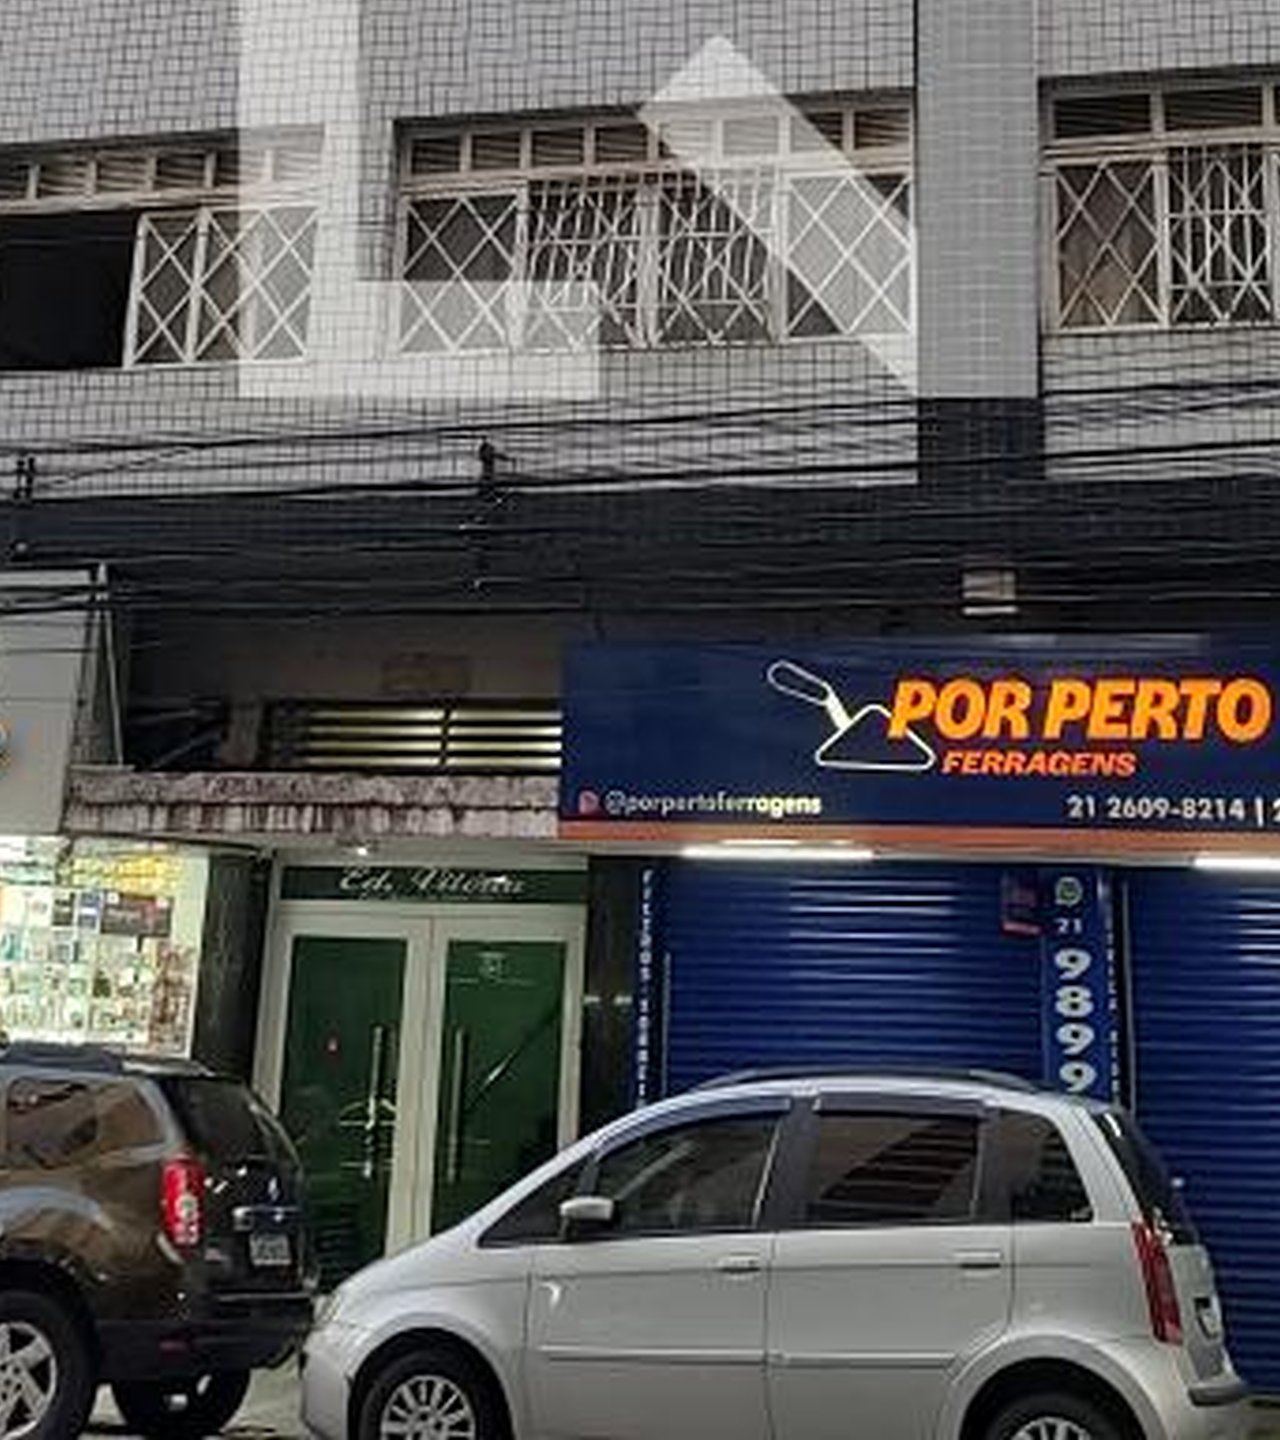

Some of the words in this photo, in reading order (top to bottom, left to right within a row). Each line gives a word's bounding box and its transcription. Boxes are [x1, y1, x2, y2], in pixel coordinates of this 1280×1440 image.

[886, 677, 1033, 740] POR
[1042, 677, 1273, 744] PERTO
[940, 750, 1138, 777] FERRAGENS
[1066, 795, 1096, 819] 21
[1108, 795, 1246, 821] 2609-8214
